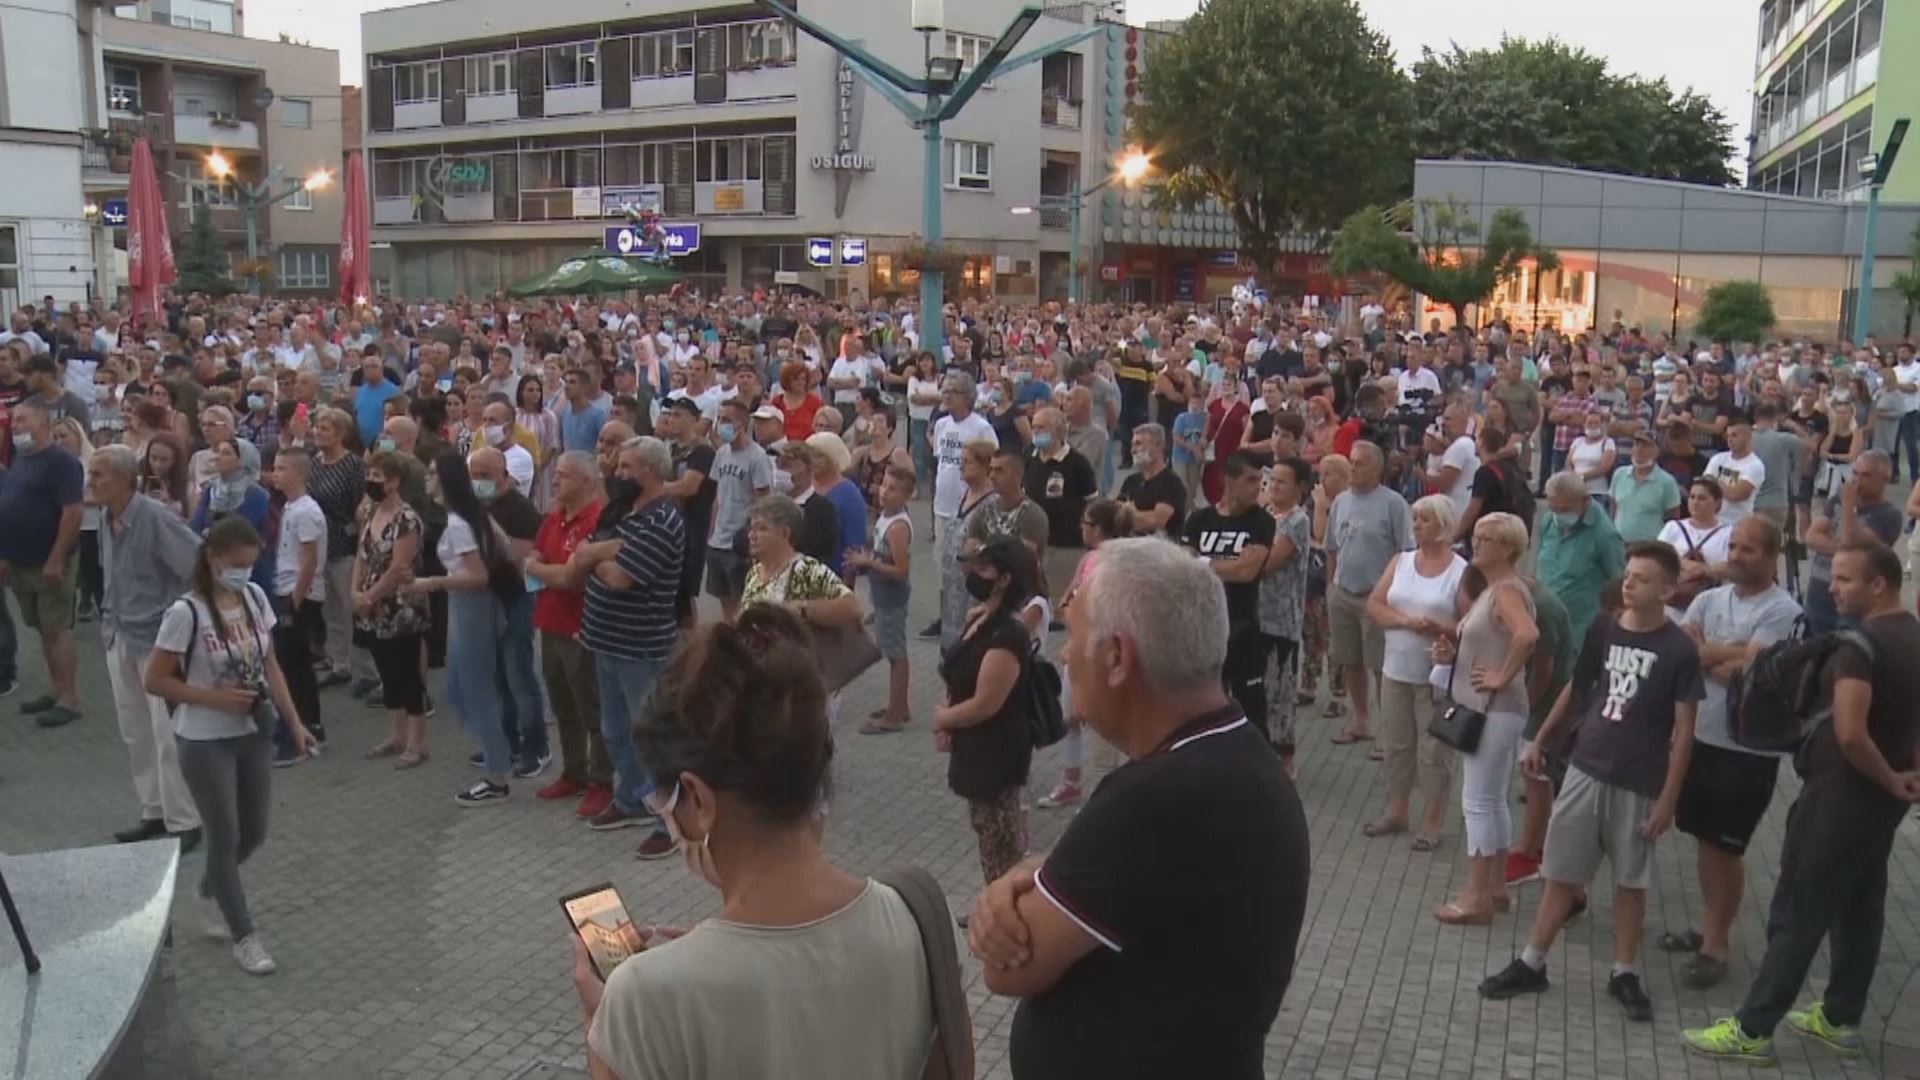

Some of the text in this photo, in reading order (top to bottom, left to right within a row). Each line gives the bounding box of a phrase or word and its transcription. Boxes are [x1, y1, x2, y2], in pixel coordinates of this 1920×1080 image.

[1199, 531, 1251, 553] UFC
[1605, 644, 1658, 679] JUST
[1609, 669, 1639, 699] DO
[1601, 695, 1627, 721] IT
